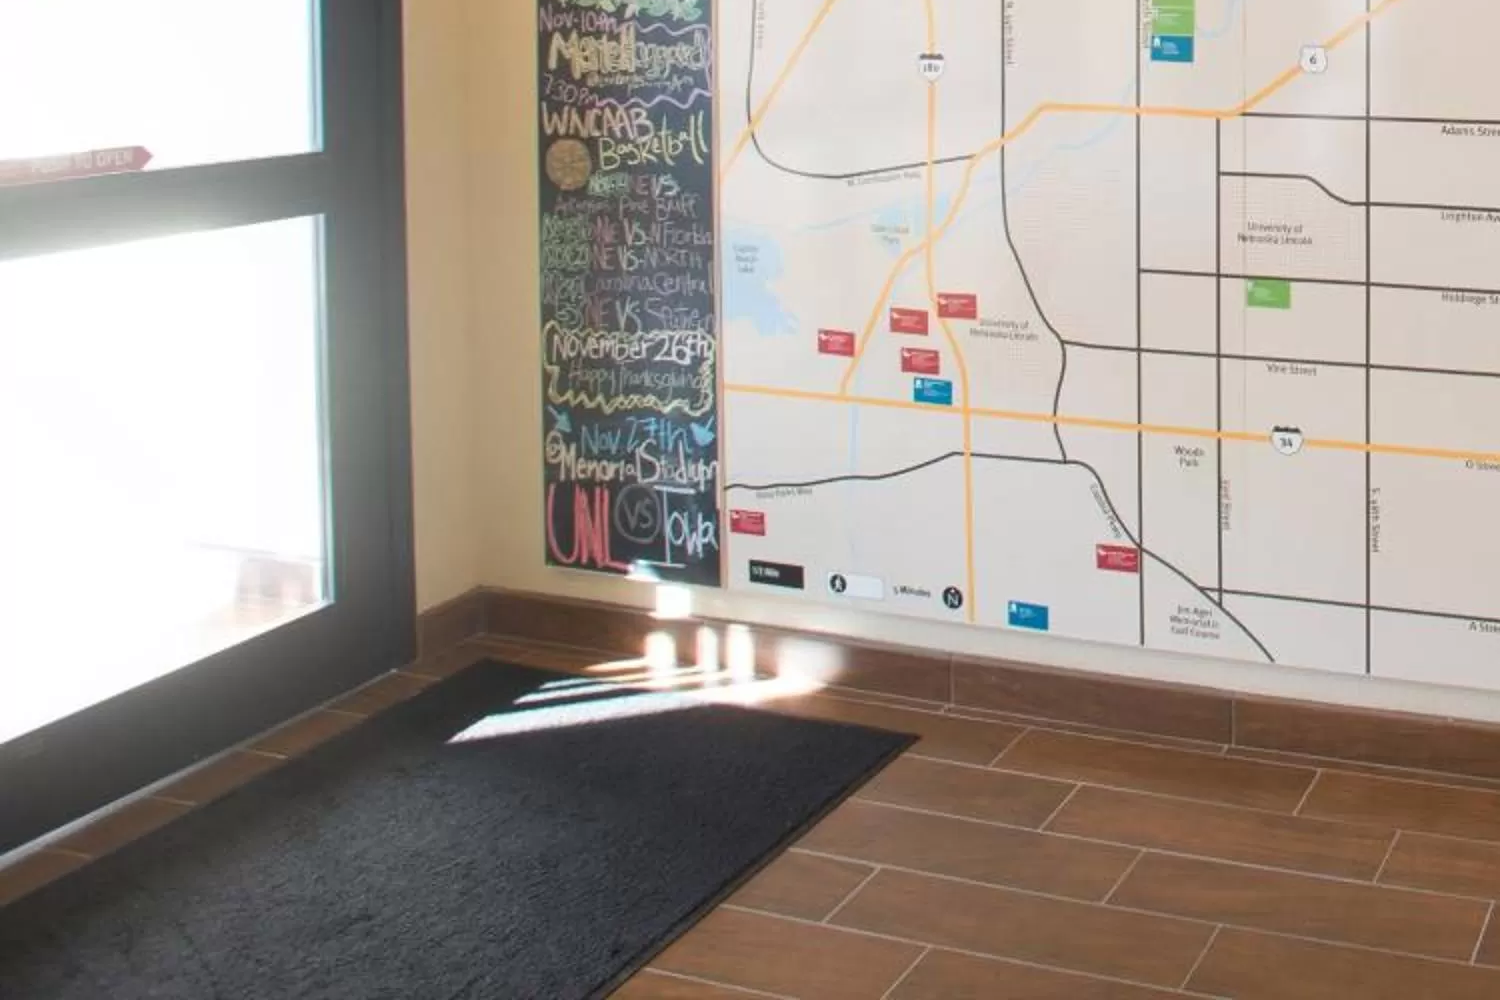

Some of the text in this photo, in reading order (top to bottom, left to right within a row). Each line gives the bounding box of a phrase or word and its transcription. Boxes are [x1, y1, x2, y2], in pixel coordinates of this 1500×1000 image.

[1309, 53, 1318, 65] 6
[1441, 125, 1475, 137] Adams
[1288, 364, 1318, 377] Street
[1179, 457, 1200, 468] Park
[1371, 523, 1381, 553] Street
